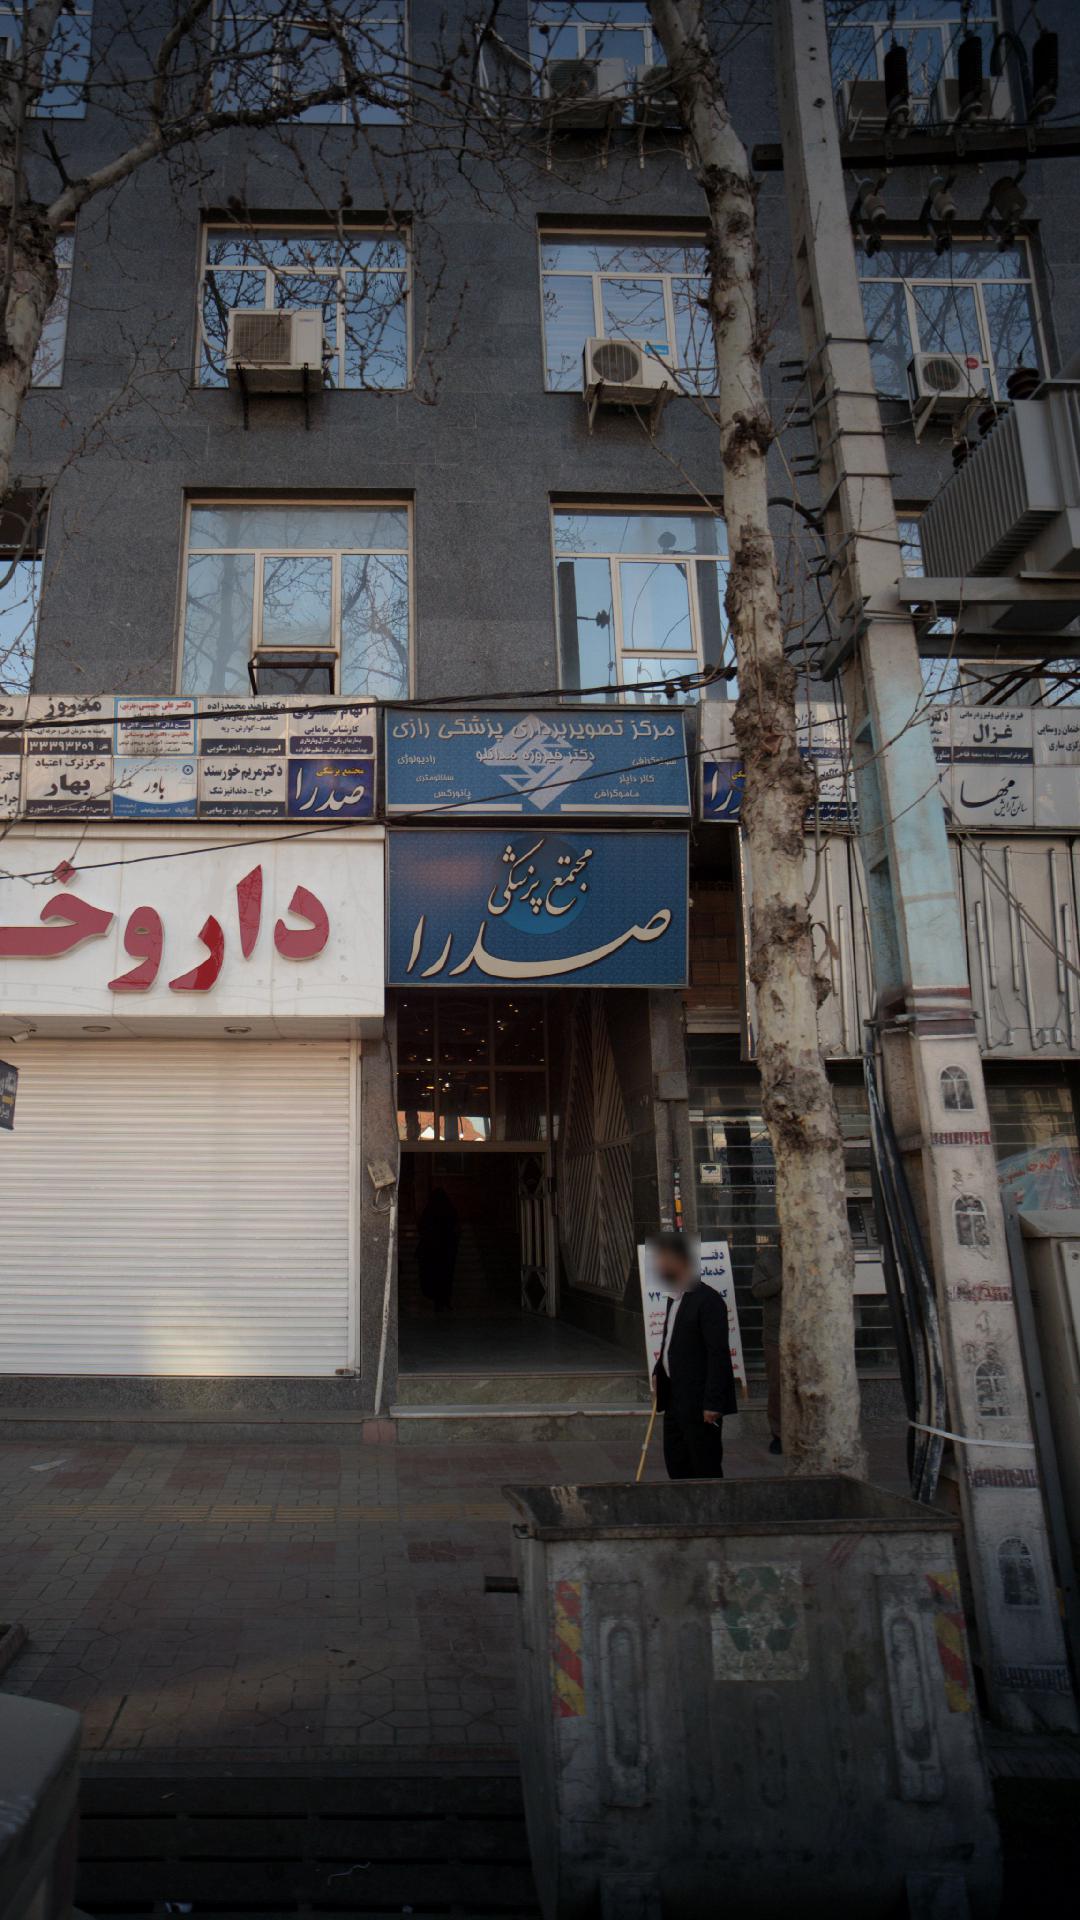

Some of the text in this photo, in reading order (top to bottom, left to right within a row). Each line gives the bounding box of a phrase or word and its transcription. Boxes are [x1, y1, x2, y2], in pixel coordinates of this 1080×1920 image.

[392, 714, 675, 741] مرکز تصویربرداری پزشکی رازی
[973, 723, 1013, 744] غزال
[397, 753, 436, 766] رادیولوژی
[523, 748, 563, 764] فیروزه
[569, 748, 596, 764] دکتر
[203, 763, 283, 780] دکتر مریم خورسند
[43, 773, 91, 797] بهار
[254, 787, 273, 797] جراح
[295, 767, 366, 813] صدرا
[0, 794, 18, 806] جرا
[487, 838, 593, 916] مجتمع پزشکی
[405, 908, 672, 979] صدرا
